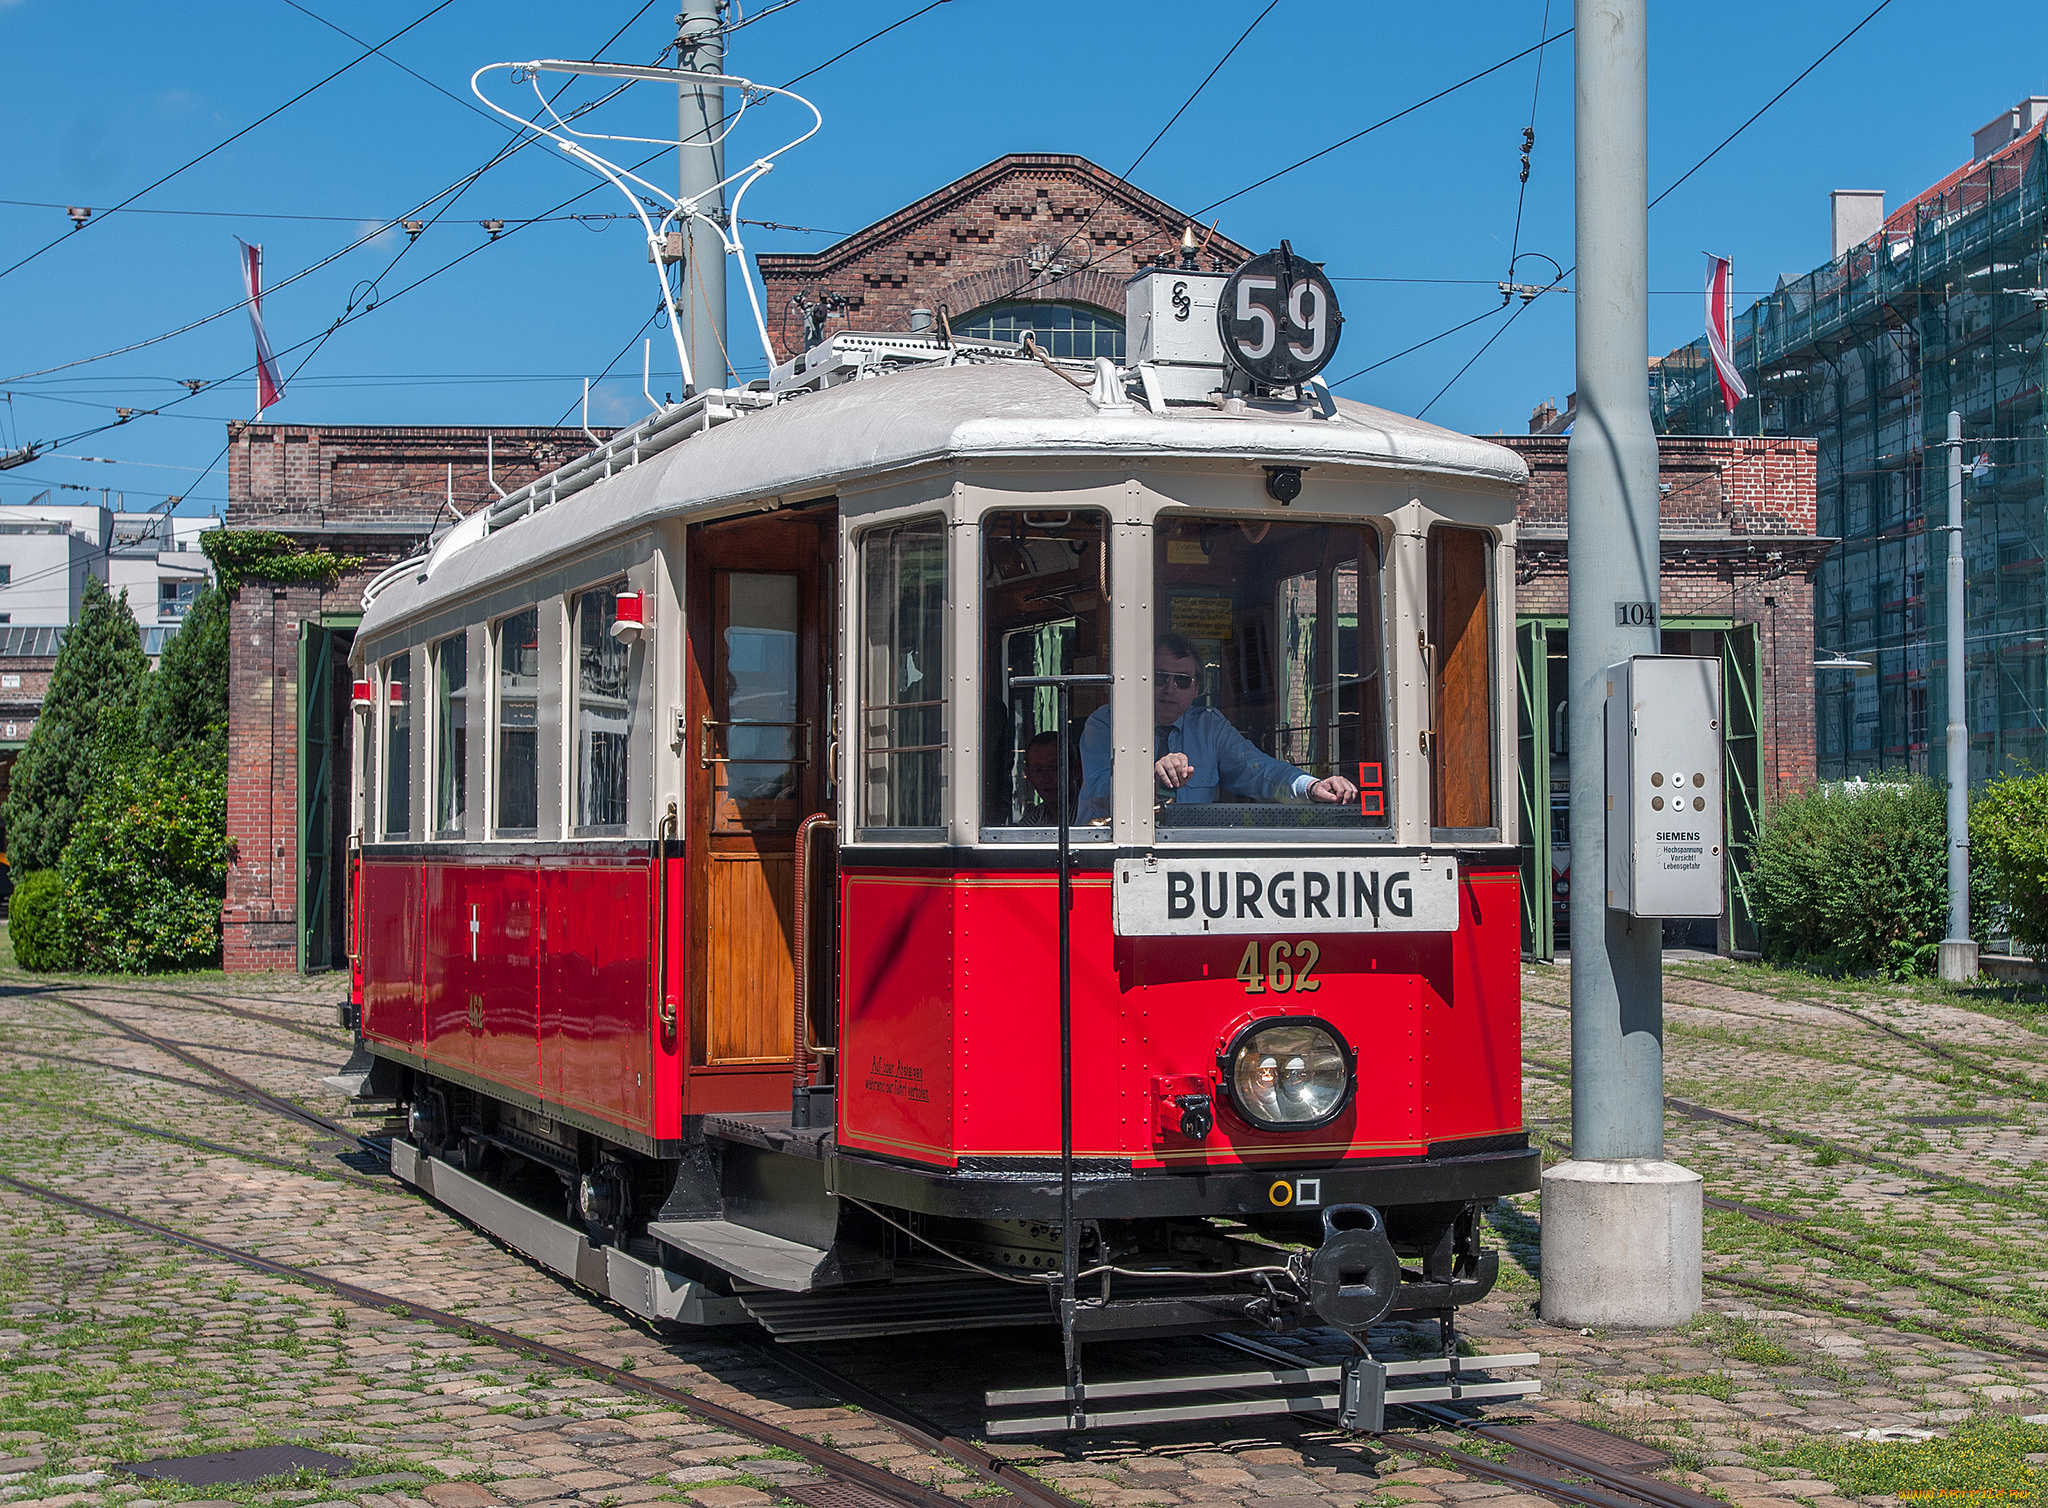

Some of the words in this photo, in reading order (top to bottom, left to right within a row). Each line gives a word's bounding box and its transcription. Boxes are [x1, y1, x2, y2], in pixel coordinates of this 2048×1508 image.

[1236, 274, 1327, 362] 59
[1618, 603, 1655, 625] 104
[1656, 832, 1700, 841] SIEMENS
[1663, 846, 1703, 854] Hochspannung
[1670, 854, 1697, 862] Vorsicht!
[1663, 862, 1701, 871] Lebensgefahr
[1167, 871, 1413, 919] BURGRING
[1236, 940, 1321, 994] 462
